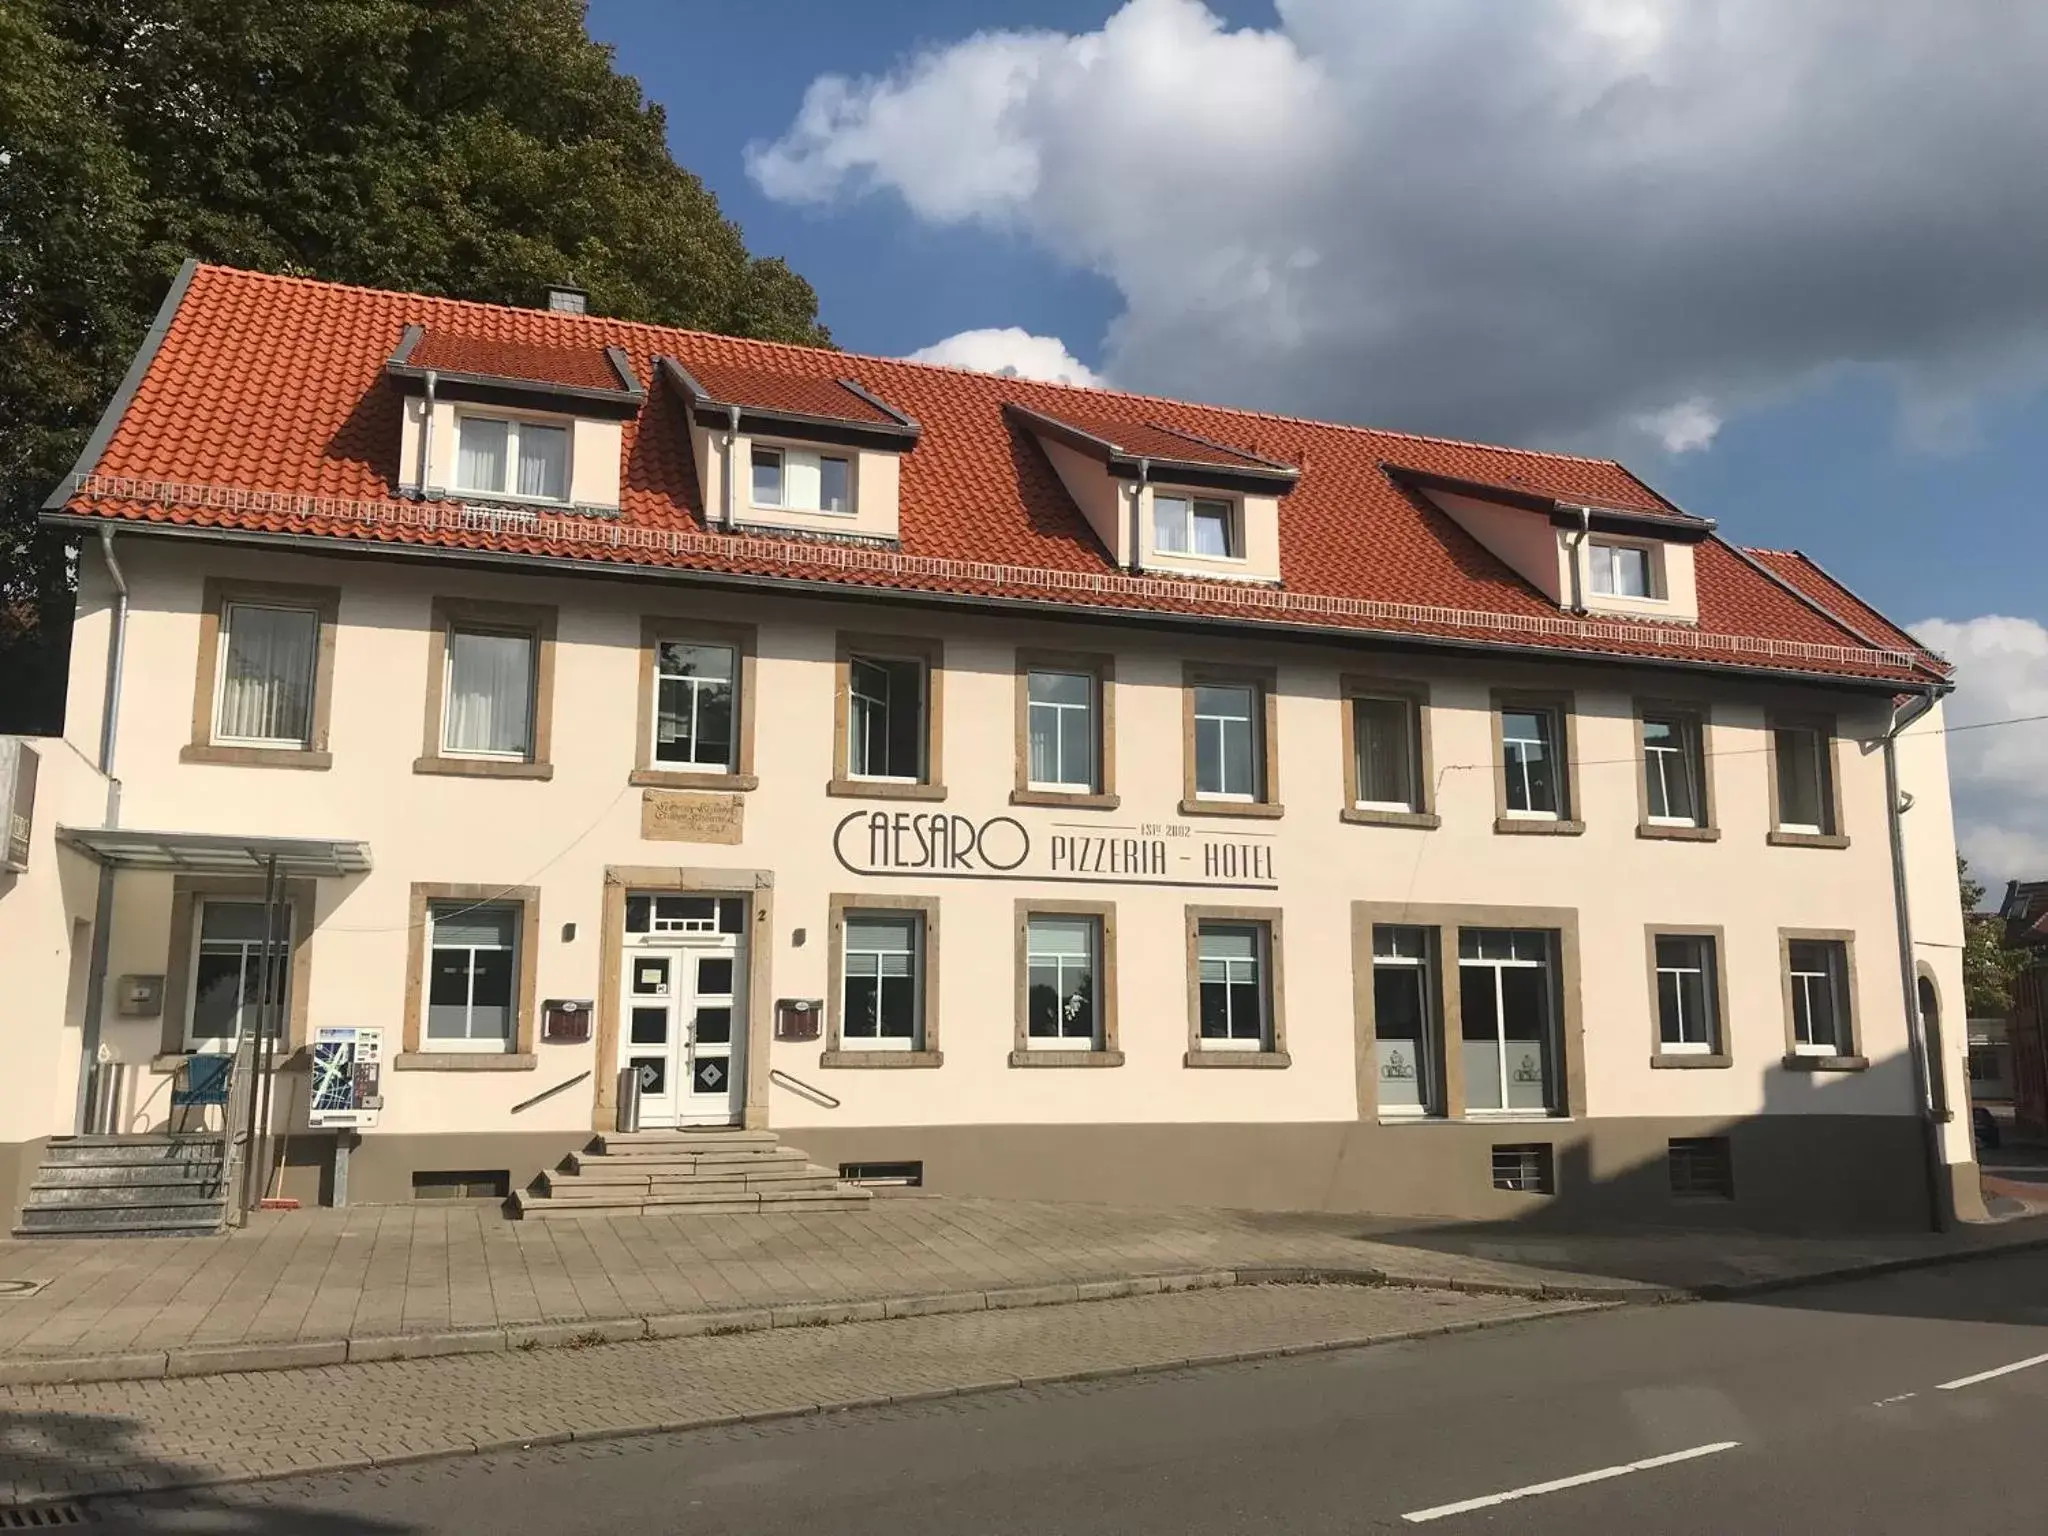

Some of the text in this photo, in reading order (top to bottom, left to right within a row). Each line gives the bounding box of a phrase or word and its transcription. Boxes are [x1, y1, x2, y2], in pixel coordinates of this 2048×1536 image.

[833, 810, 1030, 873] CAESARO
[1051, 836, 1166, 874] PIZZERIA
[1204, 843, 1278, 879] HOTEL
[758, 909, 767, 922] 2
